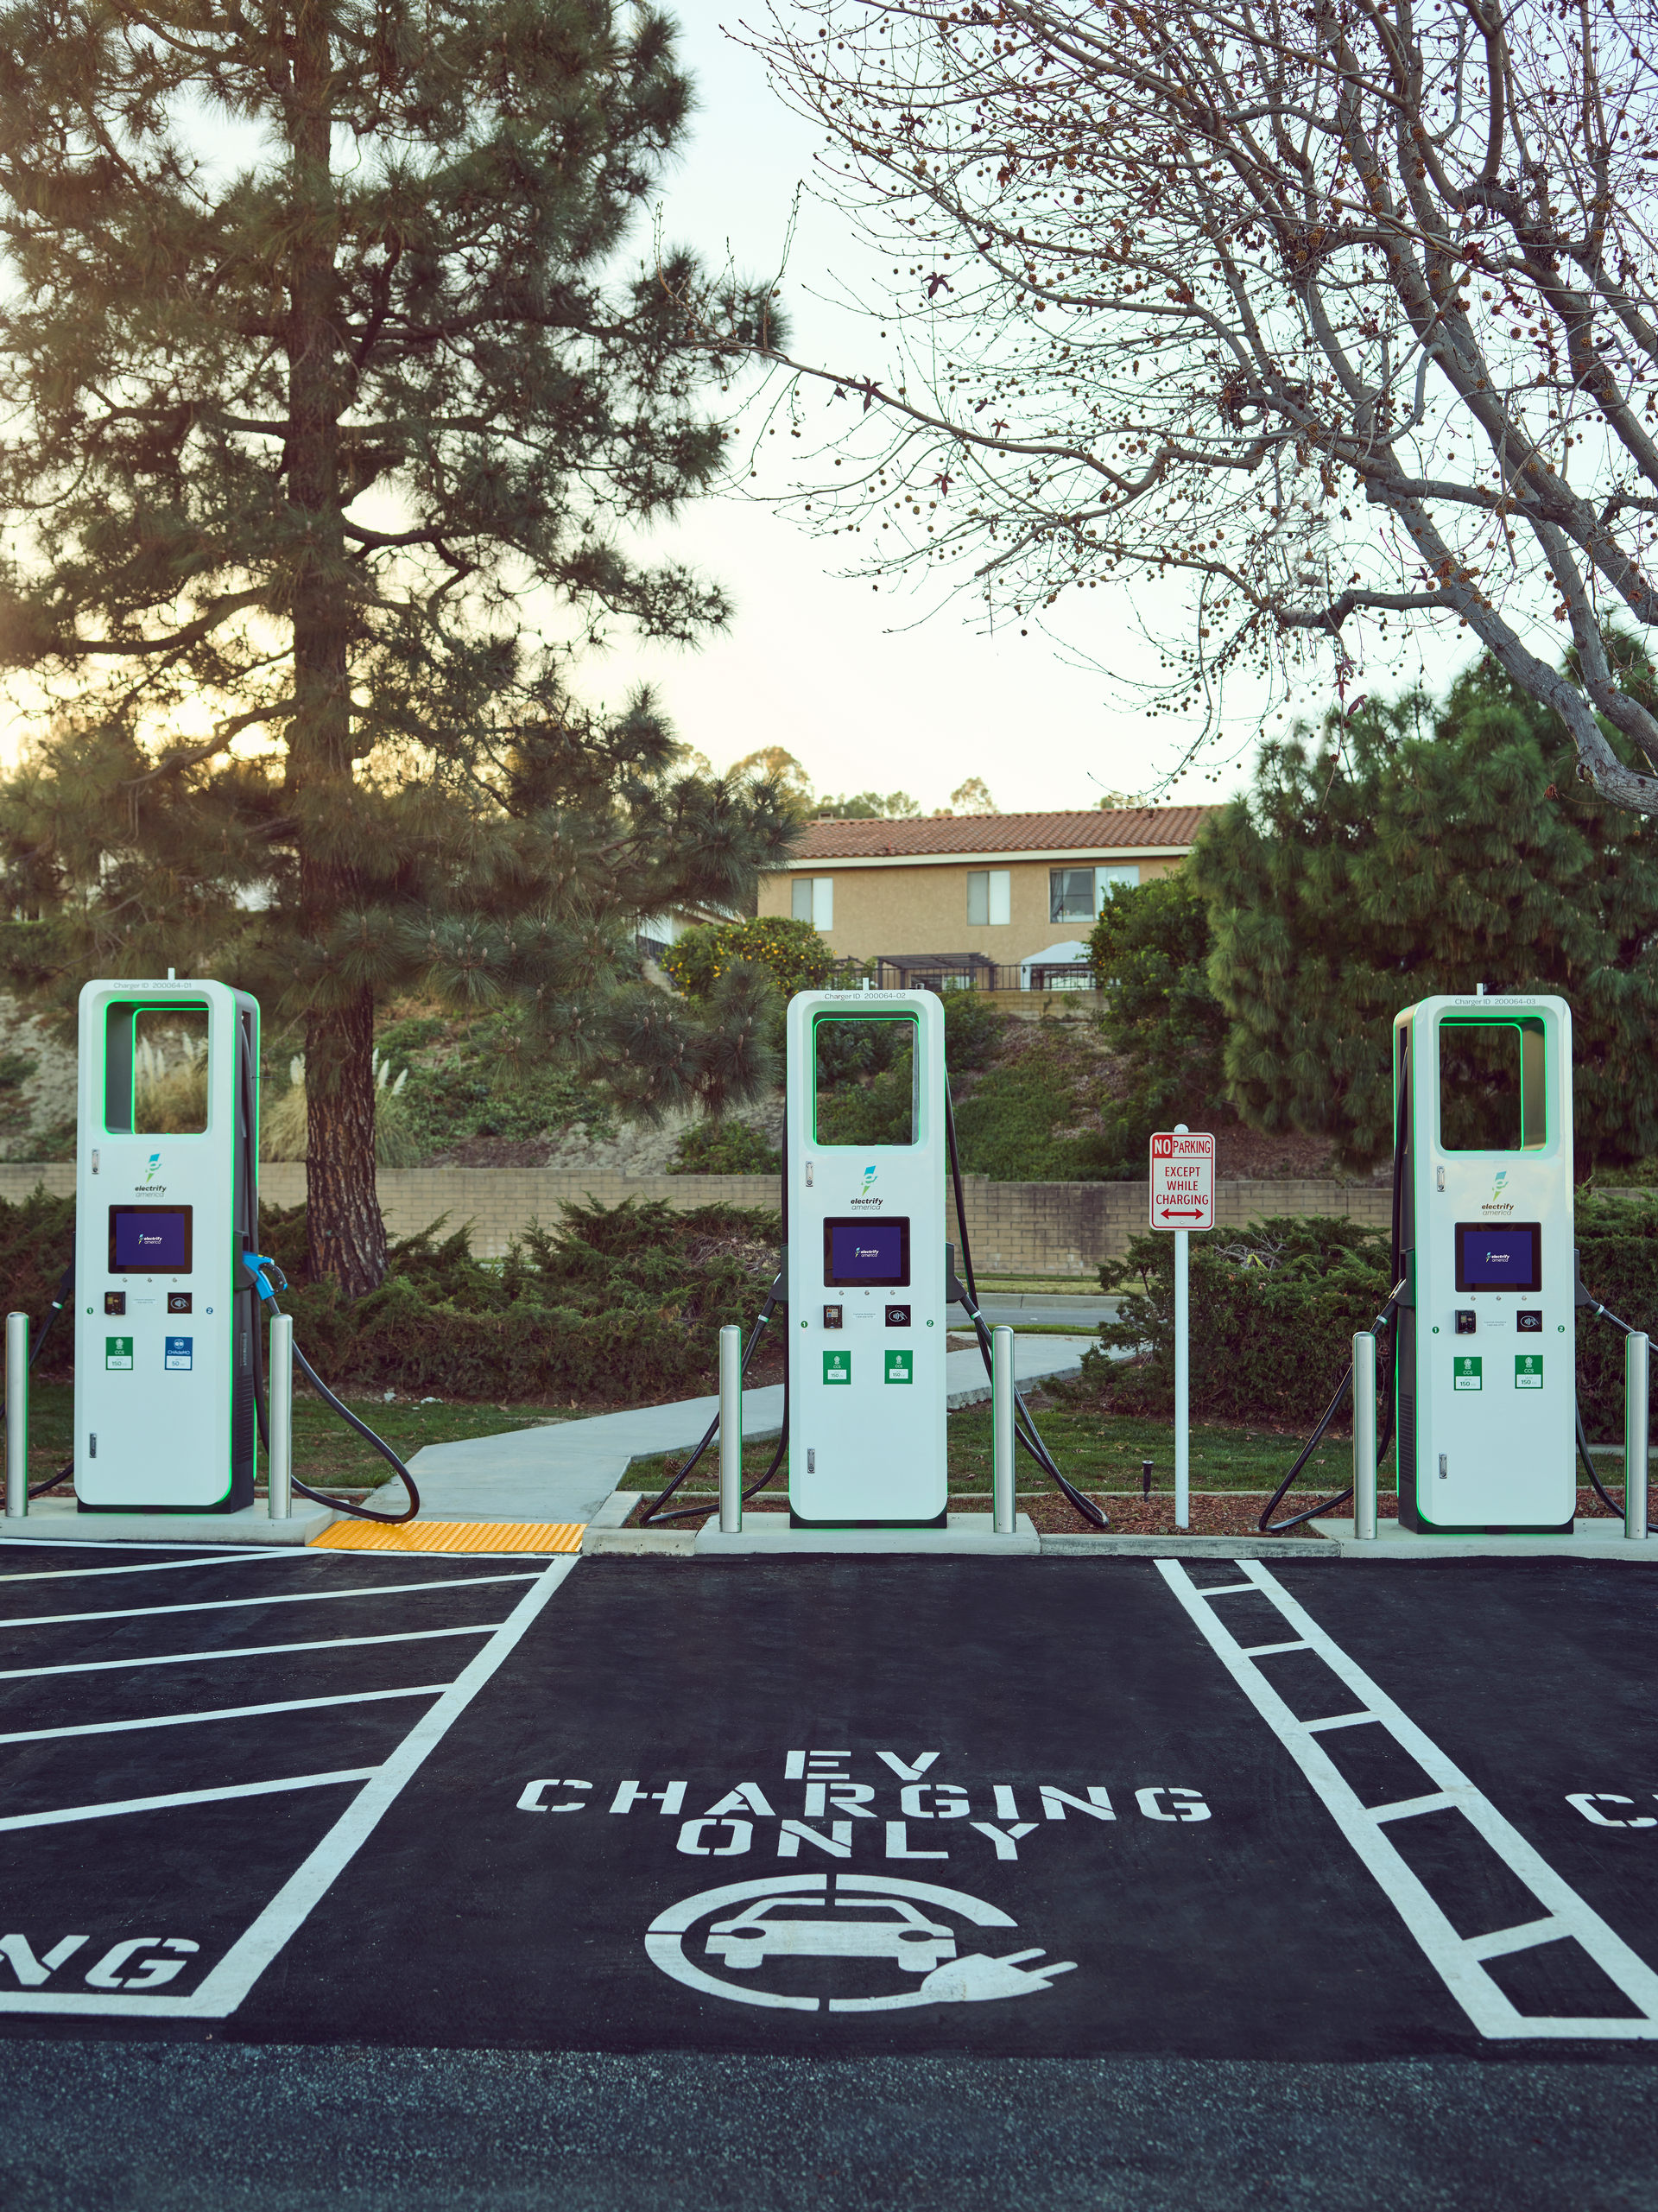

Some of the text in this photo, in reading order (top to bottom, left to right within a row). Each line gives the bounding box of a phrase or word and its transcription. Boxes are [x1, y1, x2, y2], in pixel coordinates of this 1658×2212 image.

[1154, 1139, 1211, 1155] NO PARKING
[1165, 1166, 1201, 1177] EXCEPT
[1167, 1180, 1199, 1191] WHILE
[1155, 1195, 1209, 1205] CHARGING
[784, 1750, 940, 1781] EV
[516, 1778, 1212, 1822] CHARGING
[676, 1818, 1040, 1860] ONLY
